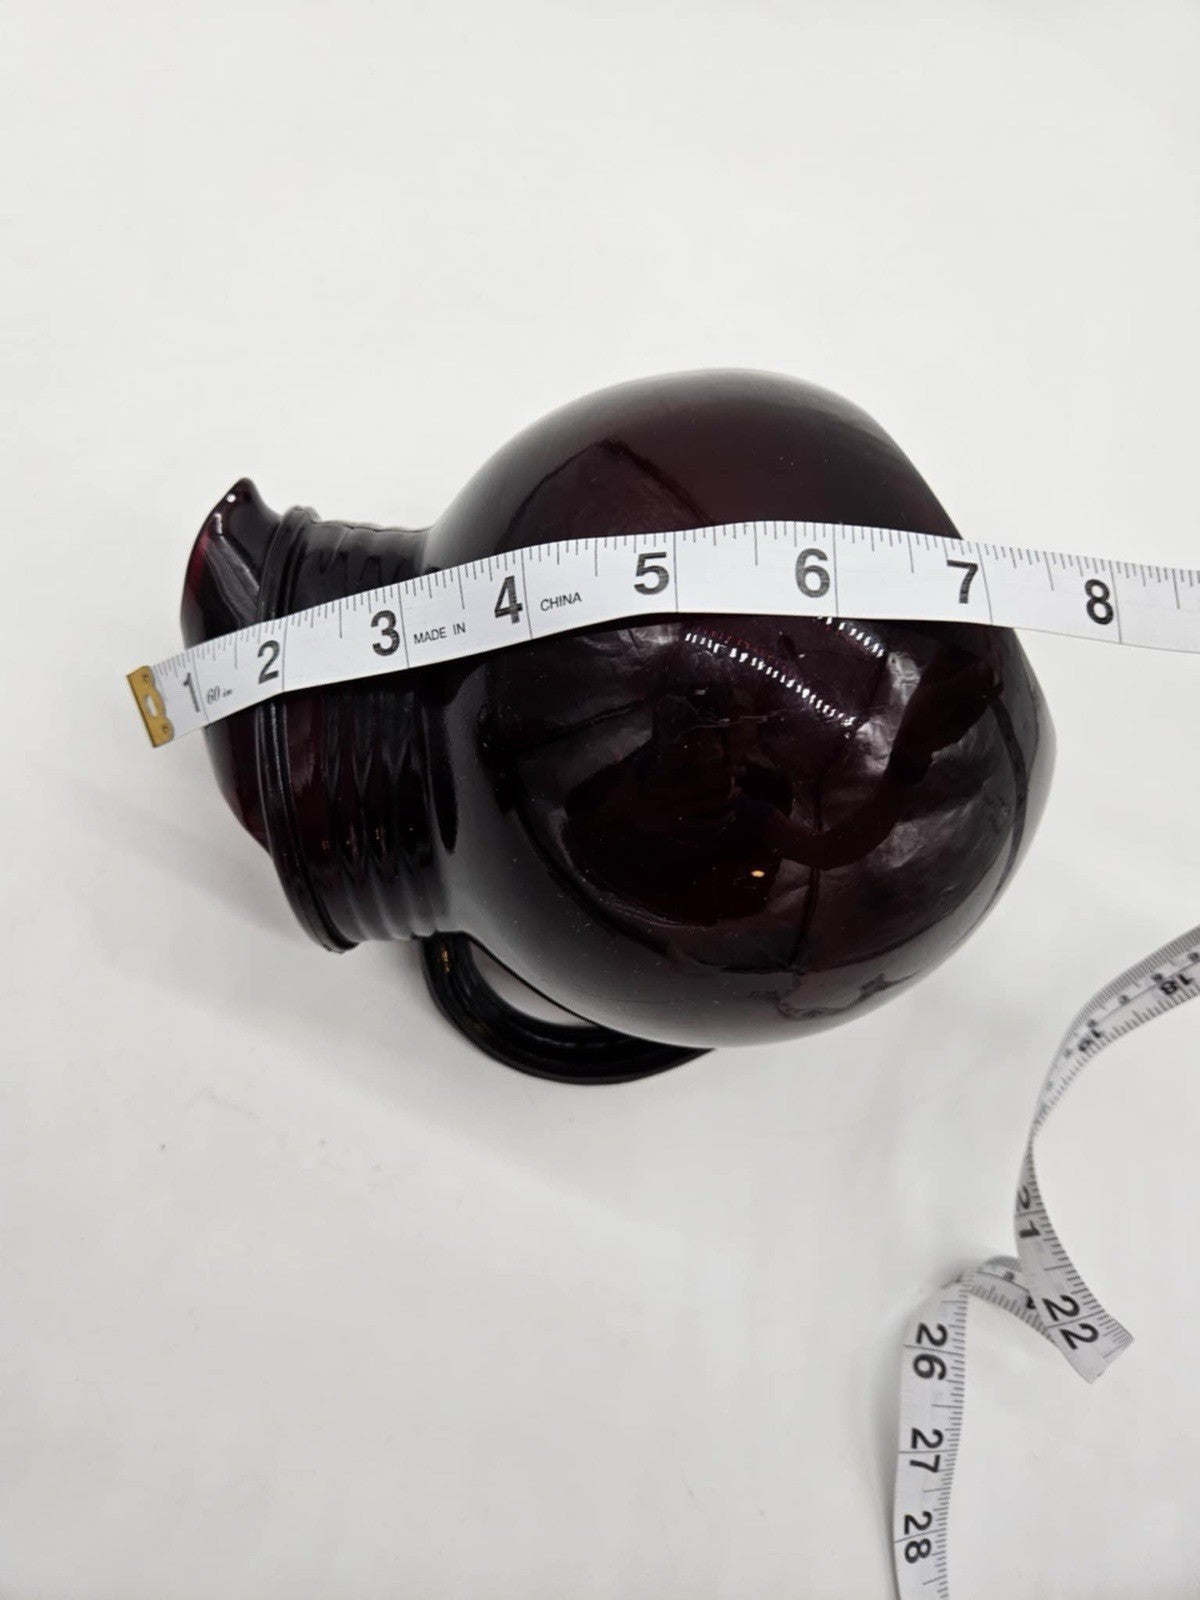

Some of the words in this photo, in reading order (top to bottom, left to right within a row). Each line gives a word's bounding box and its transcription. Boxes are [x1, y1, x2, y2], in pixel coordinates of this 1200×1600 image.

[634, 551, 670, 595] 5
[794, 548, 831, 598] 6
[946, 559, 979, 605] 7
[493, 575, 524, 624] 4
[540, 591, 582, 612] CHINA
[1084, 578, 1115, 625] 8
[370, 608, 401, 656] 3
[413, 625, 448, 645] MADE
[452, 621, 466, 635] IN
[257, 639, 282, 684] 2
[183, 672, 200, 713] 1
[1042, 1293, 1099, 1350] 22
[912, 1322, 948, 1382] 26
[909, 1427, 944, 1474] 27
[902, 1510, 933, 1565] 28
